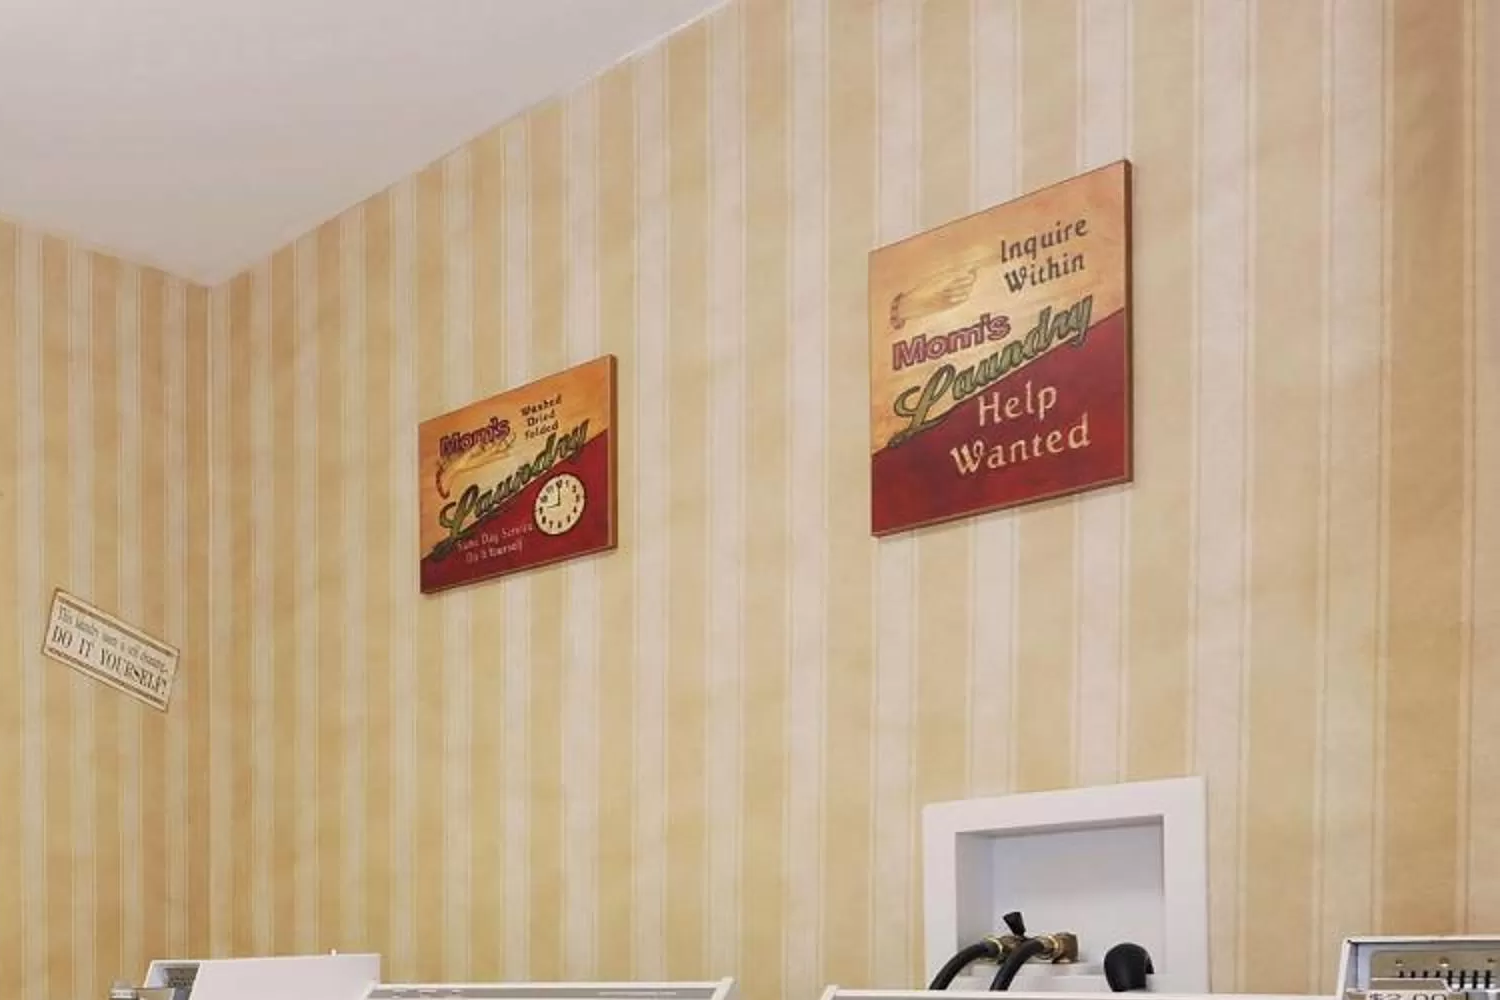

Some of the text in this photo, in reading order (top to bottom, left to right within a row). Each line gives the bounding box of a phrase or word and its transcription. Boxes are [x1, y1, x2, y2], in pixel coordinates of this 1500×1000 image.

[1000, 217, 1090, 264] Inquire
[1004, 253, 1086, 294] Within
[891, 312, 1012, 371] Mom's
[888, 294, 1094, 443] Laundry
[978, 381, 1058, 428] Help
[950, 412, 1092, 477] Wanted
